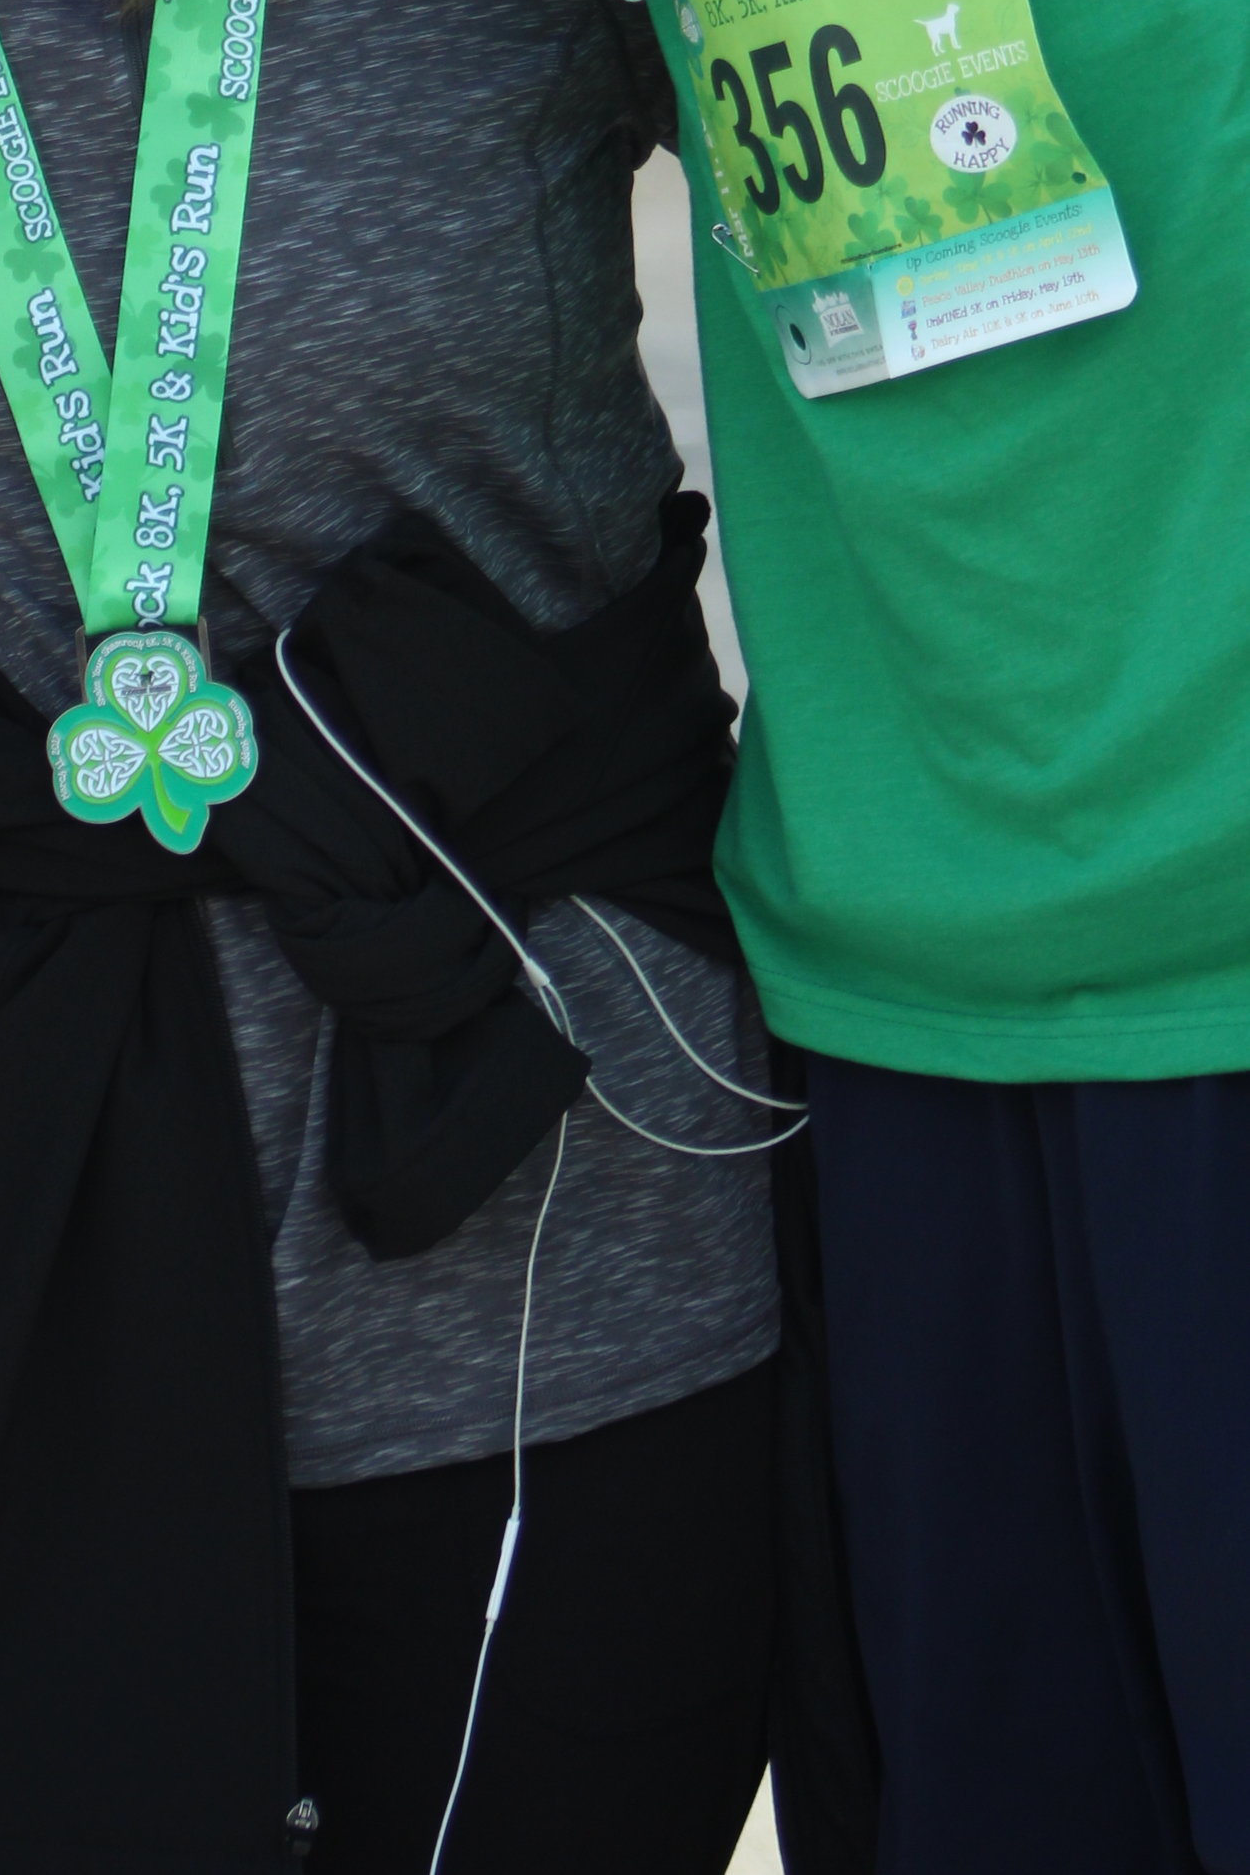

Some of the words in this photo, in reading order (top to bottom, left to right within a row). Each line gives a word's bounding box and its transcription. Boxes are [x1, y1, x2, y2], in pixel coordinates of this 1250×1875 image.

[874, 62, 955, 103] SCOOGIE
[958, 41, 1029, 81] EVENTS
[710, 24, 887, 216] 356
[935, 100, 1000, 135] RUNNING
[953, 138, 1011, 169] HAPPY
[171, 143, 220, 235] Run
[906, 256, 921, 273] Up
[925, 239, 976, 264] Coming
[986, 300, 999, 311] on
[1039, 280, 1059, 295] May
[1063, 272, 1086, 287] 19th
[28, 286, 78, 387] Run
[152, 370, 192, 403] &
[147, 413, 188, 471] 5K
